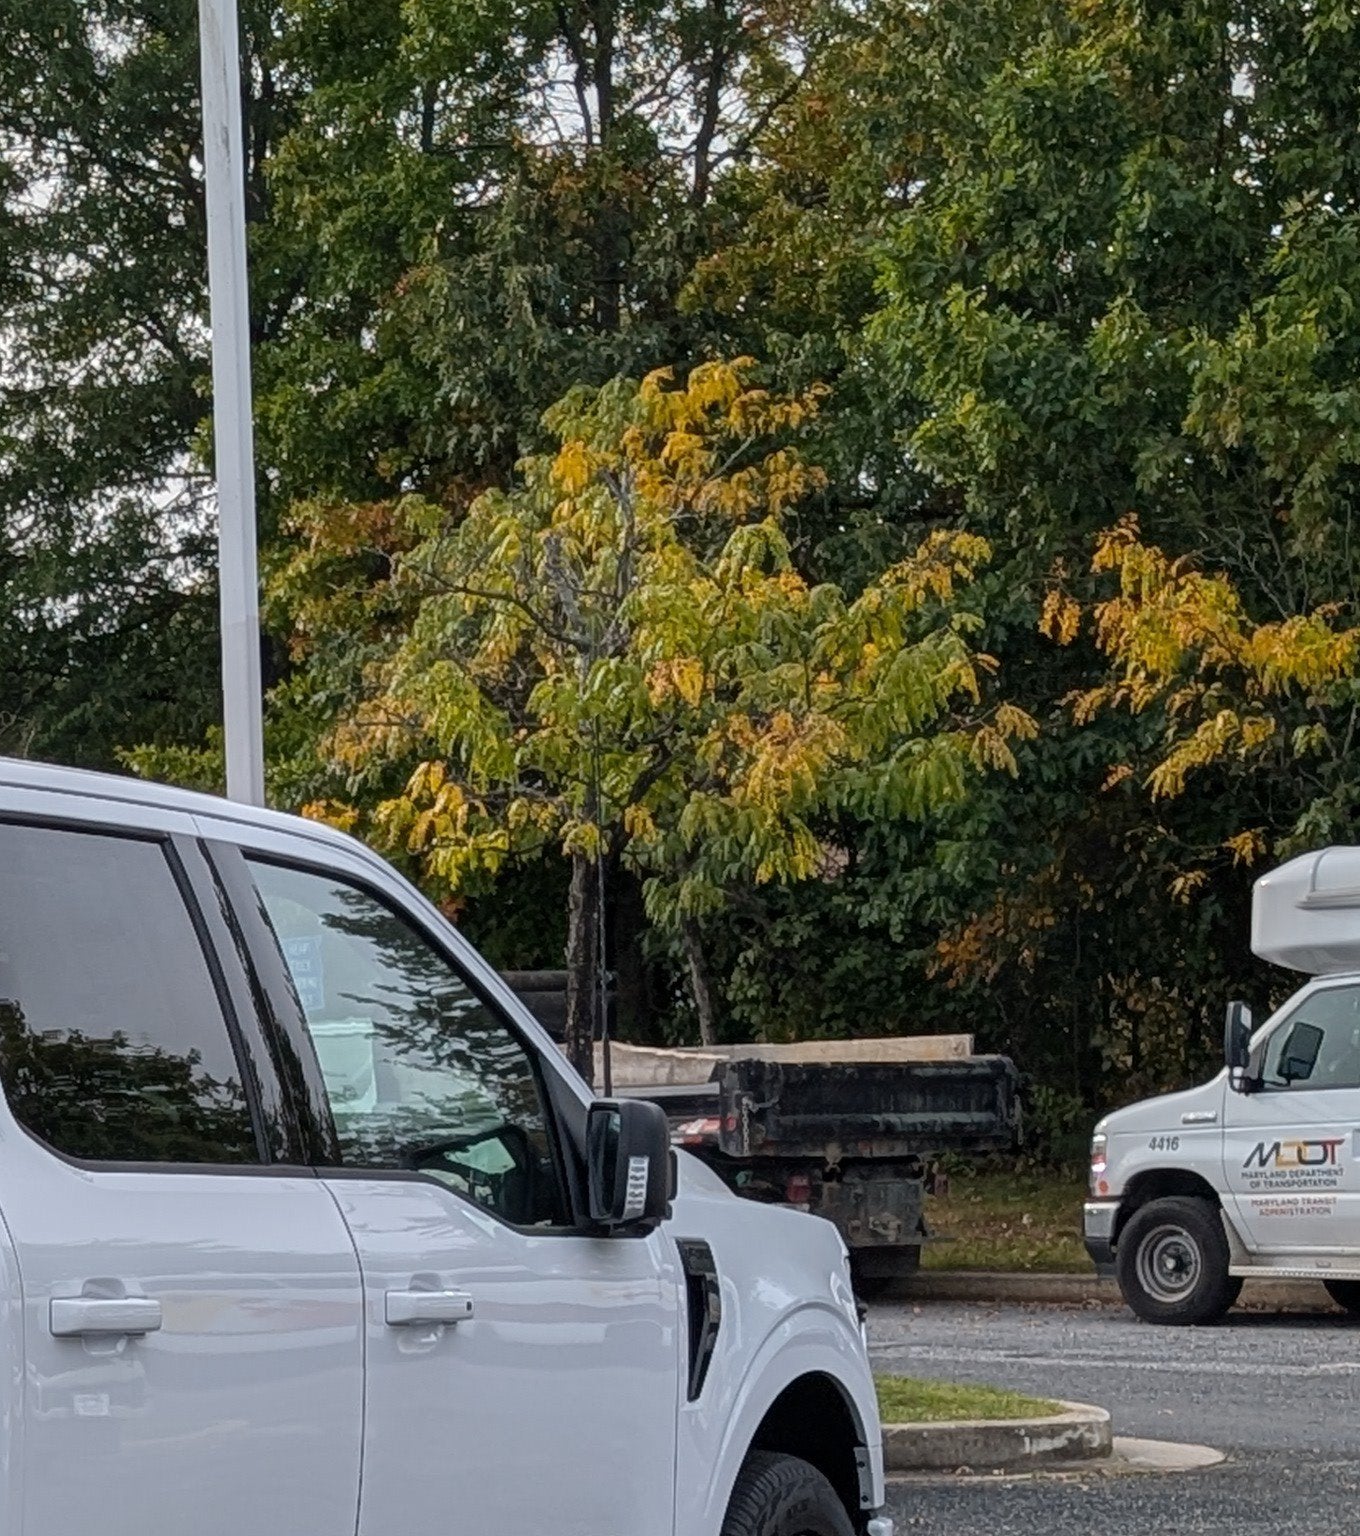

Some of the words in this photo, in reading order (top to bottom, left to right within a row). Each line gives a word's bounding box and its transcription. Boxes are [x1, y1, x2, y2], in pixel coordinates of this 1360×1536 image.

[1148, 1136, 1180, 1151] 4416
[1243, 1138, 1345, 1168] MDOT
[1241, 1171, 1287, 1180] MARYLAND
[1289, 1168, 1344, 1178] DEPARTMENT
[1249, 1180, 1261, 1189] OF
[1263, 1178, 1338, 1189] TRANSPORTATION
